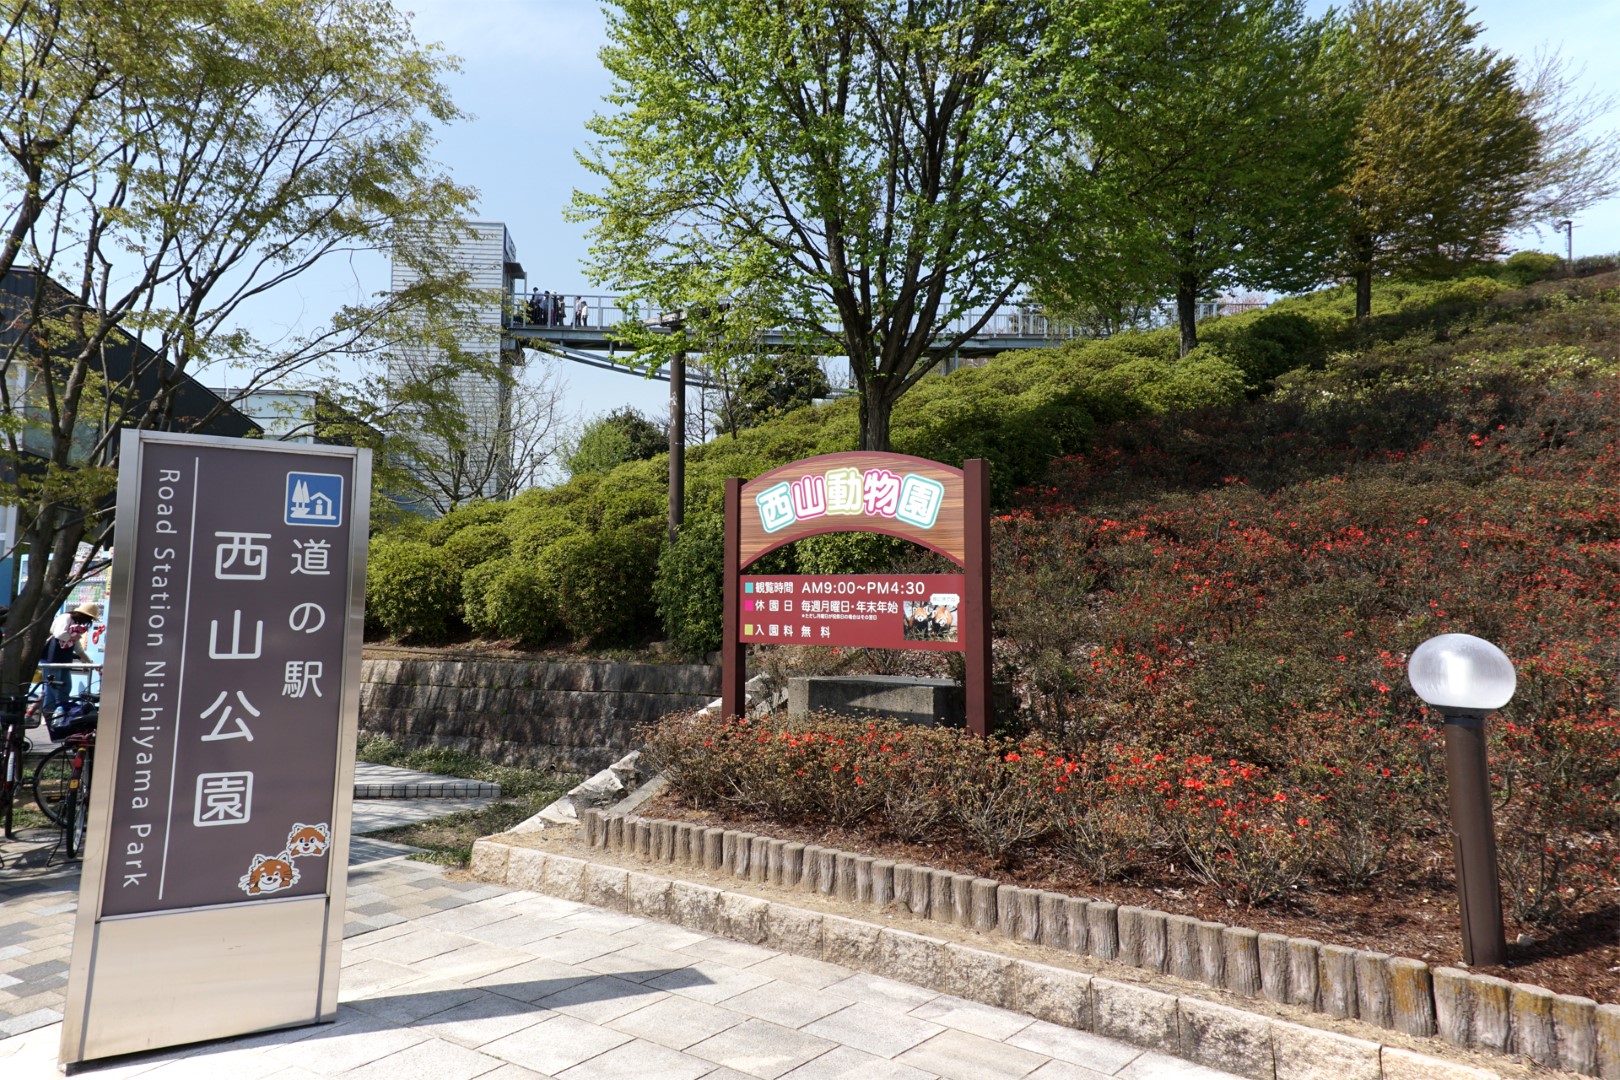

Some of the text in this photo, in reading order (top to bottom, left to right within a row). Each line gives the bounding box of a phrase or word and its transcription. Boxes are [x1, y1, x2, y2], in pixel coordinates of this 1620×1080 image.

[756, 467, 944, 534] 西山動物園
[281, 538, 331, 698] 道の駅
[755, 581, 794, 594] 観覧時間
[755, 624, 831, 638] 入園料 無料
[122, 469, 181, 888] Road Station Nishiyama Park
[193, 531, 272, 827] 西山公園
